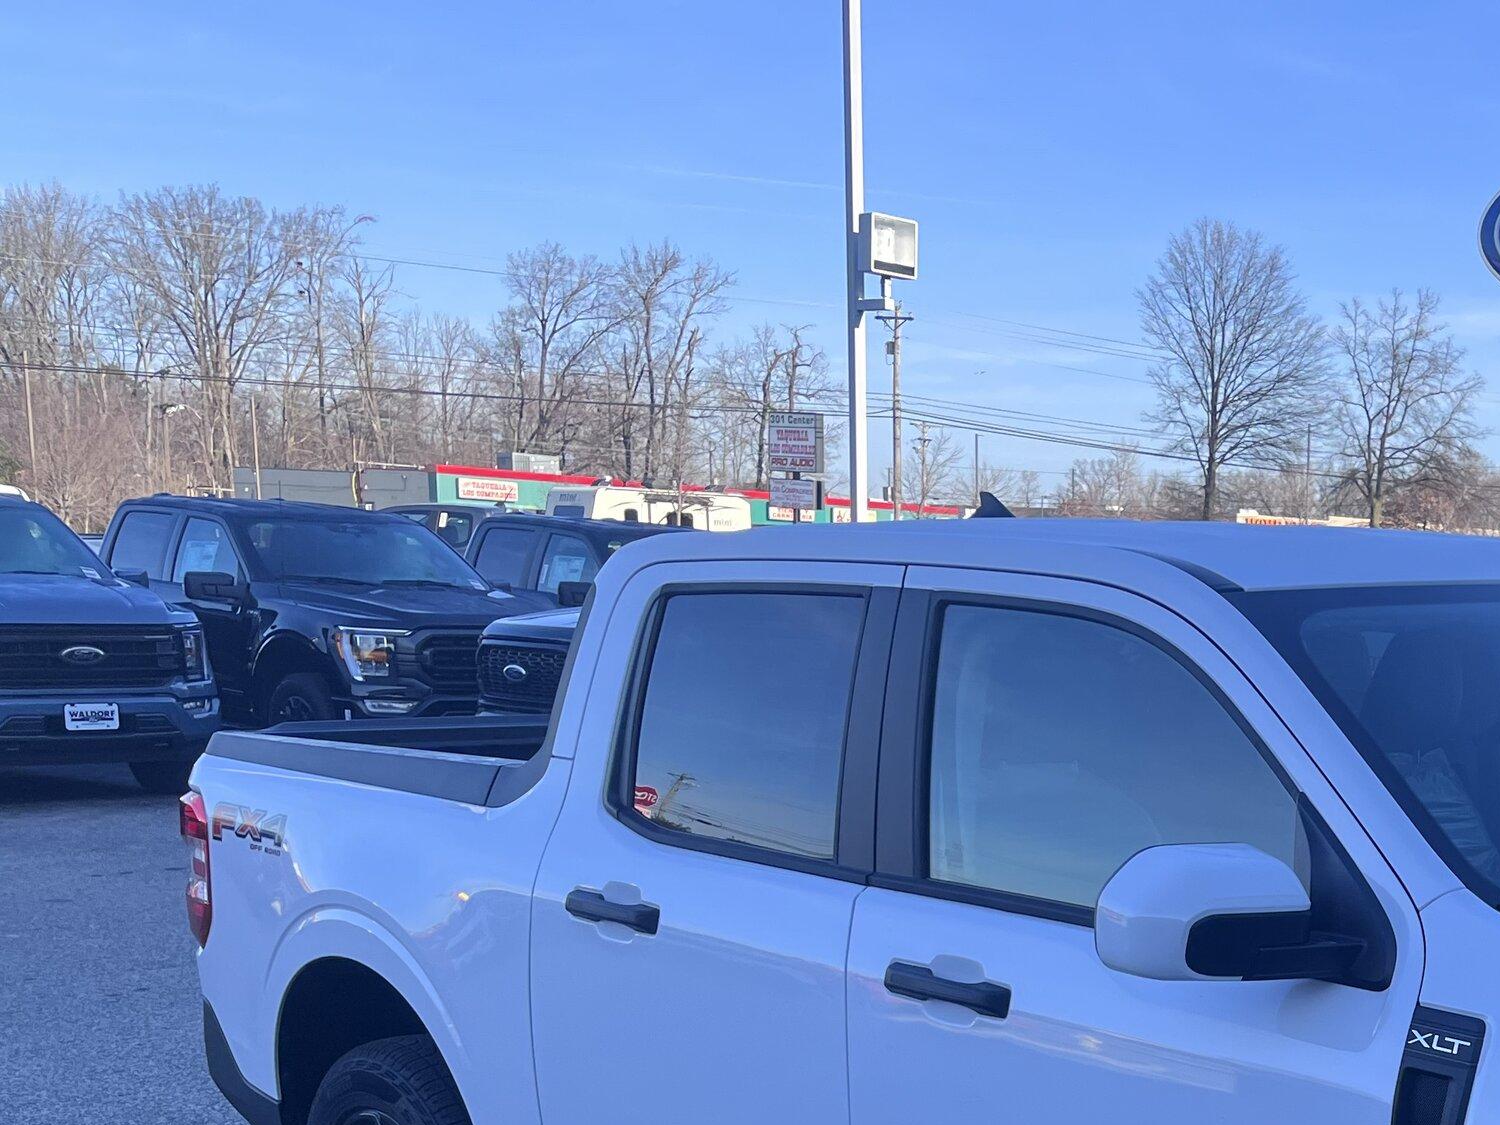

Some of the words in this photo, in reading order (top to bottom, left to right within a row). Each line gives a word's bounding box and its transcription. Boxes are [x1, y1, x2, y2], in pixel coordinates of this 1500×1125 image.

[770, 415, 785, 424] 301
[787, 415, 814, 425] Center
[771, 457, 787, 466] PRO
[790, 458, 814, 468] AUDIO
[69, 710, 115, 718] WALDORF
[212, 801, 288, 847] FX4
[249, 843, 263, 851] OFF
[264, 844, 281, 857] ROAD
[1408, 1029, 1471, 1055] XLT
